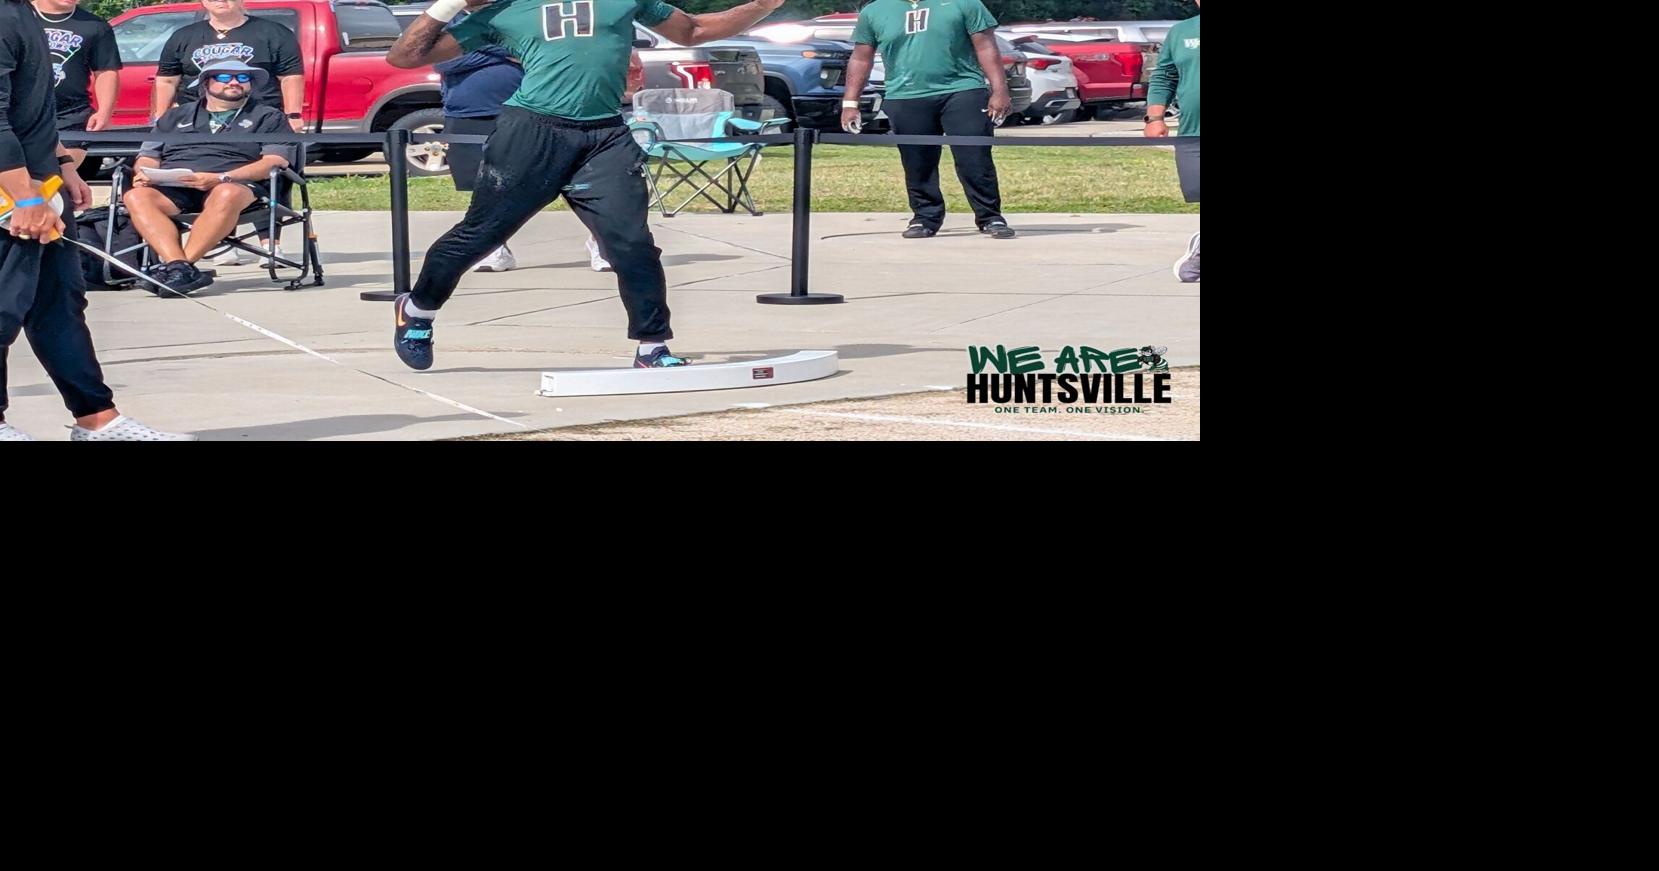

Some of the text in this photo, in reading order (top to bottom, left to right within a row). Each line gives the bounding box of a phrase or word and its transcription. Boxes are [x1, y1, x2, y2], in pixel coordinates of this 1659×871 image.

[542, 0, 594, 41] H
[905, 7, 930, 34] H
[194, 45, 254, 59] COUGAR
